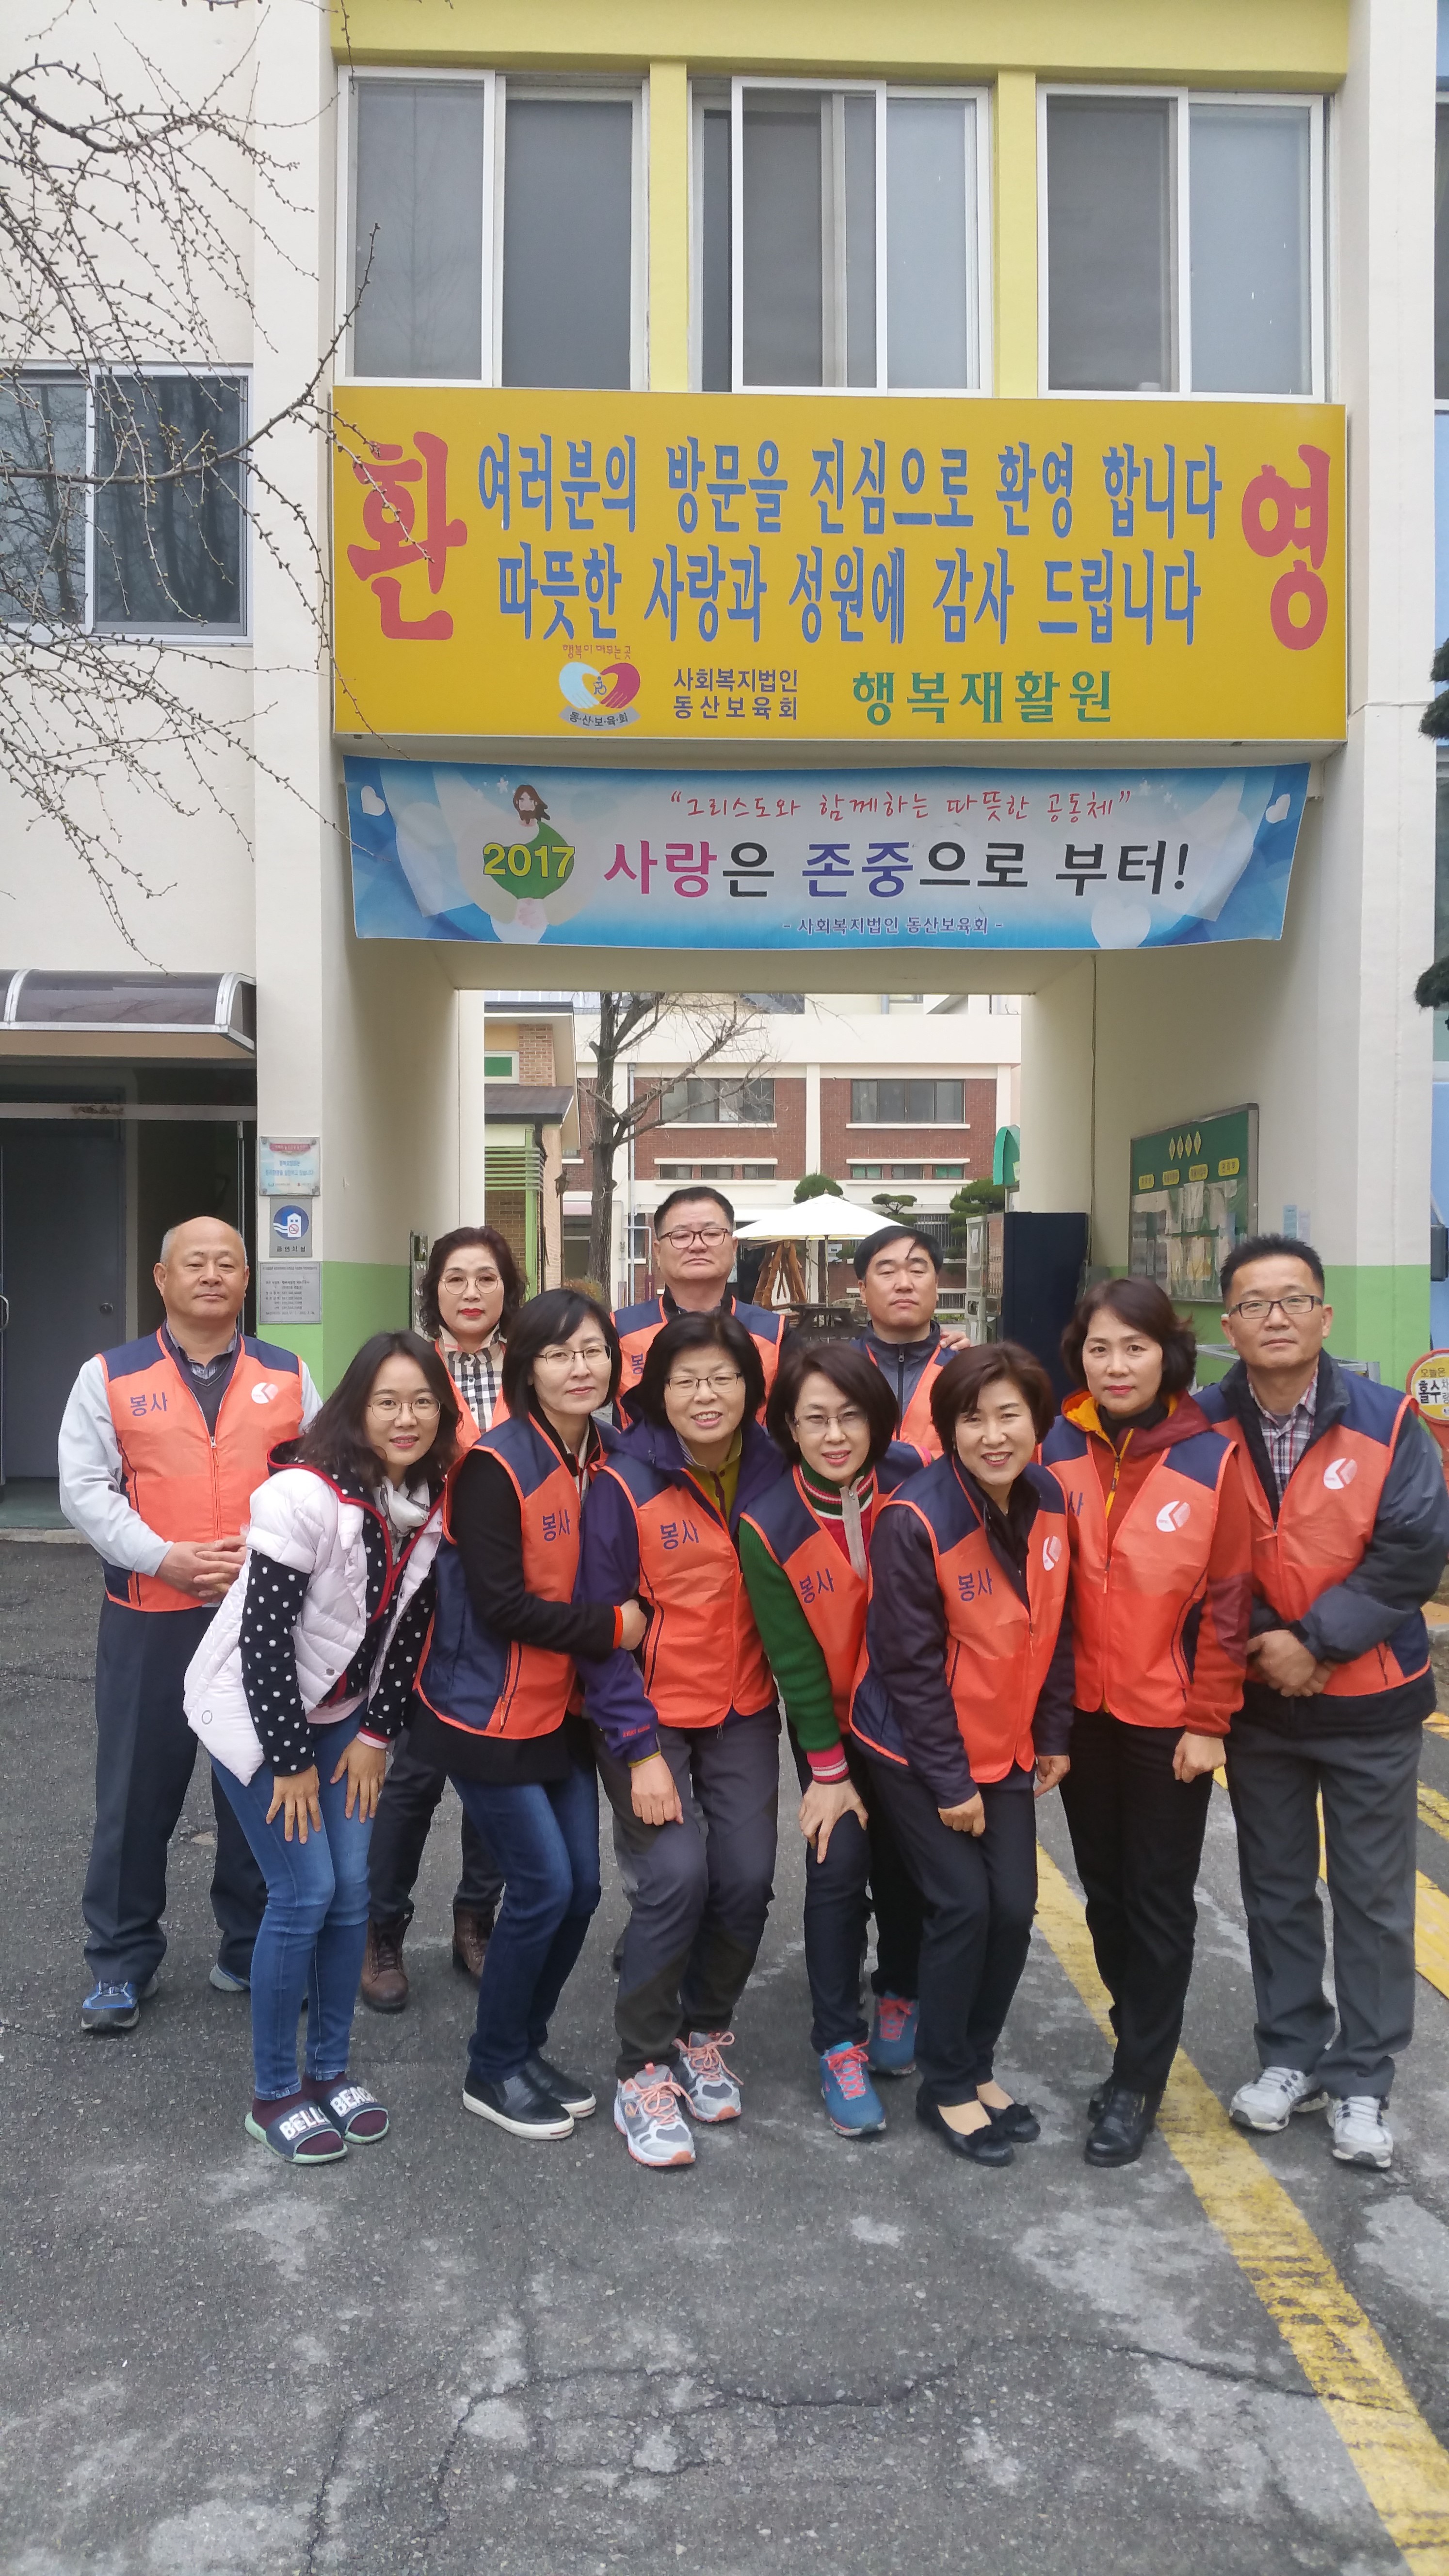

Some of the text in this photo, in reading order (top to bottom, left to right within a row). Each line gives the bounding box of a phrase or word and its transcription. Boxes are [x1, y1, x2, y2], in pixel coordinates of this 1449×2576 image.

[478, 433, 1223, 540] 여러분의 방문을 진심으로 환영 합니다
[1241, 444, 1330, 651] 영
[498, 541, 1202, 646] 따뜻한 사랑과 성원에 감사 드립니다
[673, 668, 798, 693] 사회복지법인
[673, 695, 798, 721] 동산보육회
[853, 670, 1111, 725] 행복재활원
[819, 791, 928, 821] 함께하는
[947, 790, 1030, 821] 따뜻한
[483, 842, 575, 878] 2017
[603, 839, 1190, 898] 사랑은 존중으로 부터!
[798, 916, 988, 935] 사회복지법인 동산보육회
[631, 1353, 644, 1375] 봉
[1421, 1367, 1446, 1378] 오늘은
[129, 1392, 168, 1417] 봉사
[1418, 1380, 1441, 1404] 홀수
[1067, 1491, 1084, 1517] 사
[542, 1508, 570, 1542] 봉사
[660, 1519, 699, 1550] 봉사
[799, 1567, 835, 1604] 봉사
[958, 1568, 993, 1602] 봉사
